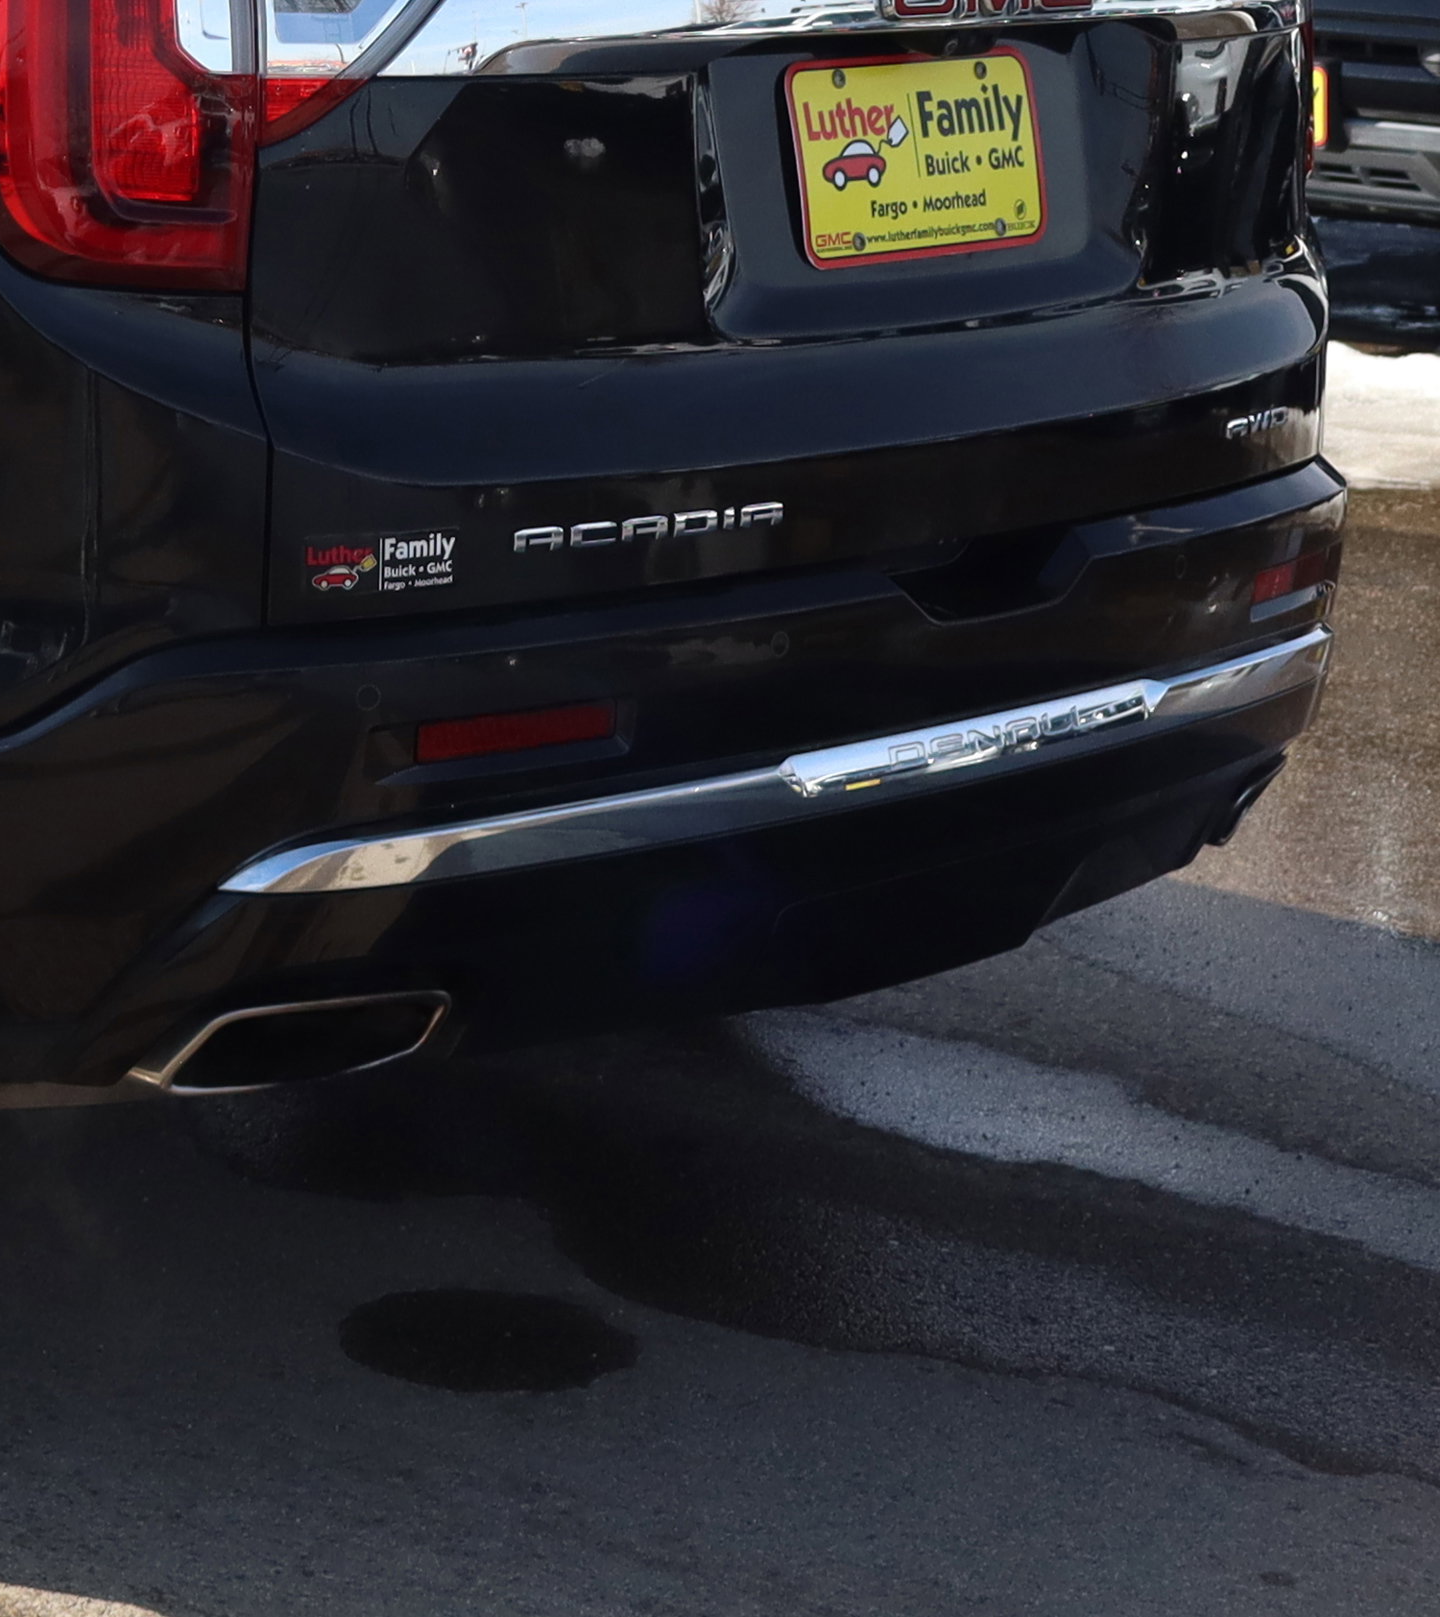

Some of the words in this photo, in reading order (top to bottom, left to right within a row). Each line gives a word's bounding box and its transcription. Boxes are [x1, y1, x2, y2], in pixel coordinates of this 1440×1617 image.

[802, 97, 895, 142] Luther
[915, 83, 1023, 142] Family
[924, 150, 971, 177] Buick
[988, 145, 1025, 171] GMC
[870, 198, 908, 220] Fargo
[922, 188, 987, 213] Moorhead
[815, 231, 853, 248] GMC
[513, 501, 784, 553] ACADIA
[305, 545, 374, 566] Luther
[384, 532, 456, 561] Family
[383, 564, 416, 579] Buick
[426, 560, 453, 574] GMC
[383, 580, 406, 591] Fargo
[414, 574, 454, 588] Moorhead
